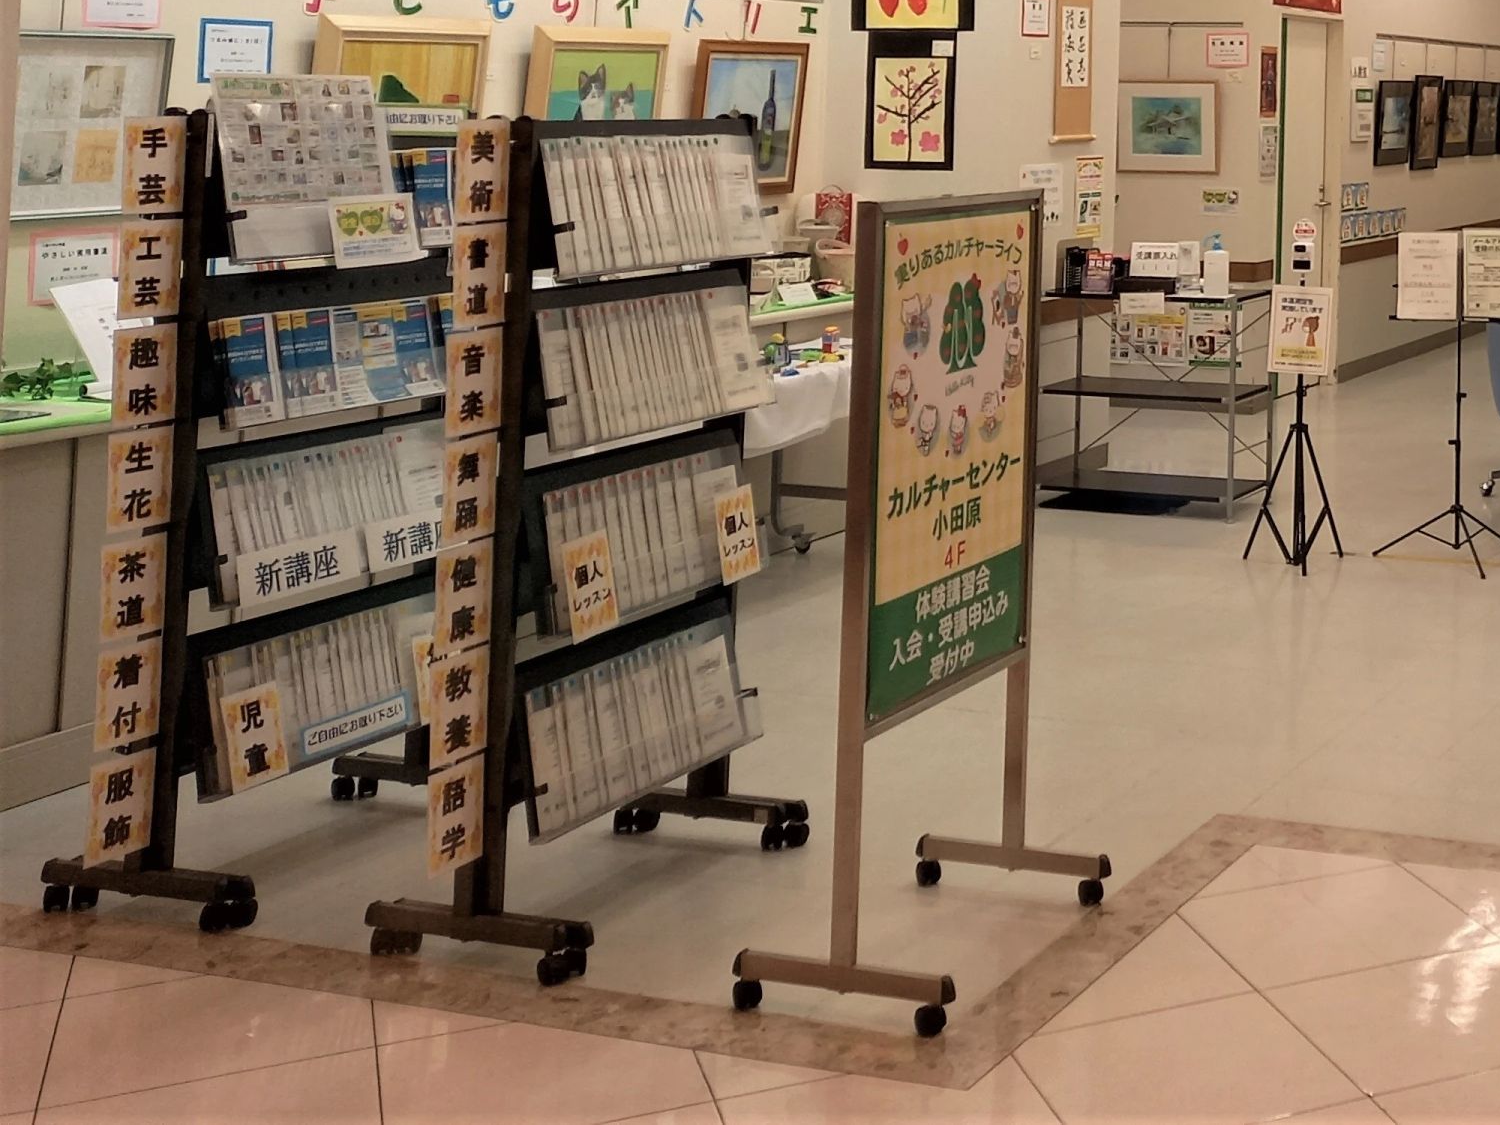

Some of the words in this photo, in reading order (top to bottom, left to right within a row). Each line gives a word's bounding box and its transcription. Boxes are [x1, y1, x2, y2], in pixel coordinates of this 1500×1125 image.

[138, 128, 167, 205] 手芸
[470, 131, 494, 213] 美術
[134, 236, 162, 307] 工芸
[466, 238, 489, 315] 書道
[894, 237, 1022, 290] 実りあるカルチャーライフ
[128, 337, 159, 415] 趣味
[460, 344, 485, 421] 音楽
[123, 442, 154, 522] 生花
[455, 452, 480, 532] 舞踊
[887, 451, 1021, 520] カルチャーセンター
[932, 496, 981, 541] 小田原
[722, 536, 756, 558] レッスン
[723, 510, 749, 535] 個人
[944, 540, 966, 569] 4F
[117, 552, 146, 628] 茶道
[254, 545, 341, 597] 新講座
[449, 556, 478, 643] 健康
[572, 588, 612, 612] レッスン
[573, 564, 604, 591] 個人
[915, 564, 991, 623] 体験講習会
[889, 589, 1009, 672] 入会・受講申込み
[926, 639, 975, 686] 受付中
[112, 655, 143, 737] 着付
[307, 703, 403, 746] ご自由にお取り下さい
[445, 668, 473, 754] 教養
[239, 700, 270, 777] 児童
[103, 767, 133, 850] 服飾
[440, 777, 467, 860] 語学
